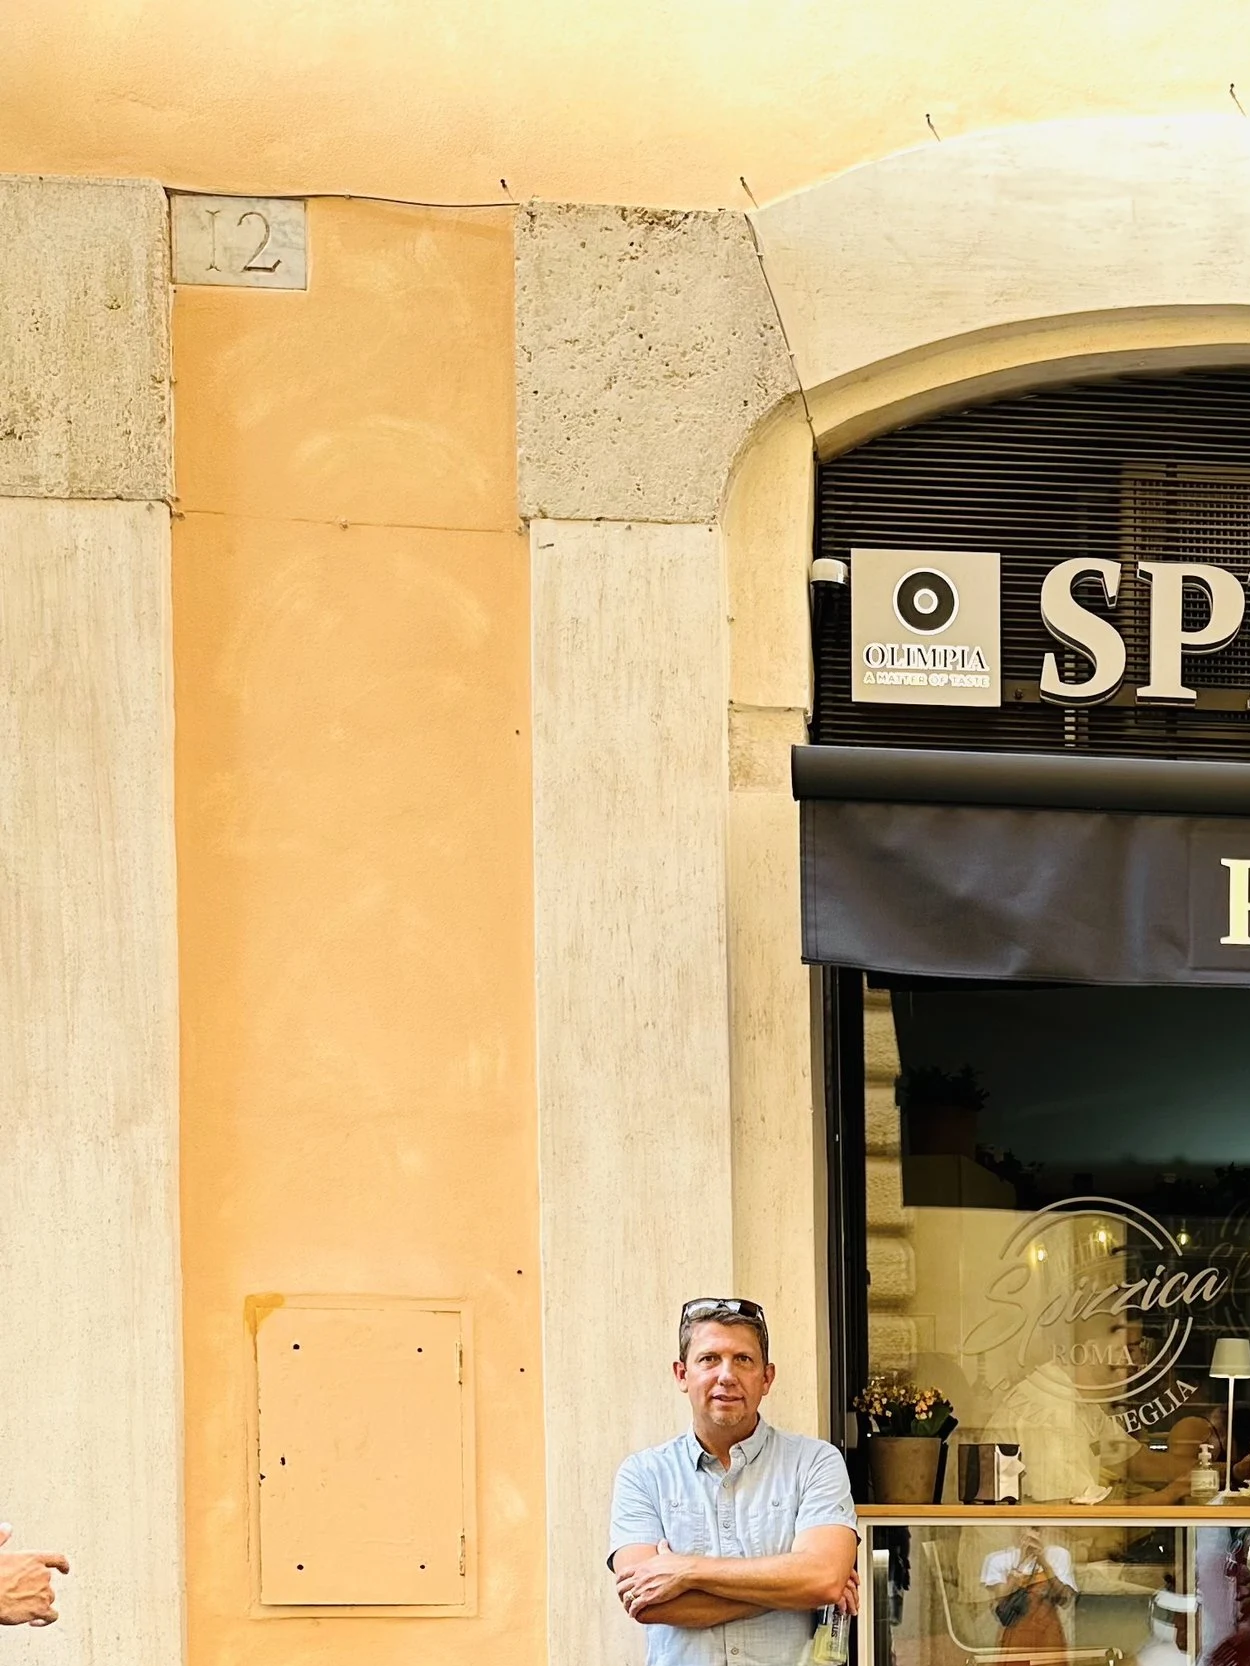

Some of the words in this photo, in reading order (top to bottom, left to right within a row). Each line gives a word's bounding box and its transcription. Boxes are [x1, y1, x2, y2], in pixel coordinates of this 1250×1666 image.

[204, 209, 282, 273] 12
[863, 642, 990, 671] OLIMPIA
[864, 672, 875, 684] A
[877, 672, 927, 686] MATTER
[929, 673, 949, 687] OF
[951, 675, 990, 687] TASTE
[963, 1263, 1229, 1367] Spizzica
[1051, 1344, 1137, 1367] ROMA
[1108, 1379, 1199, 1434] TEGLIA
